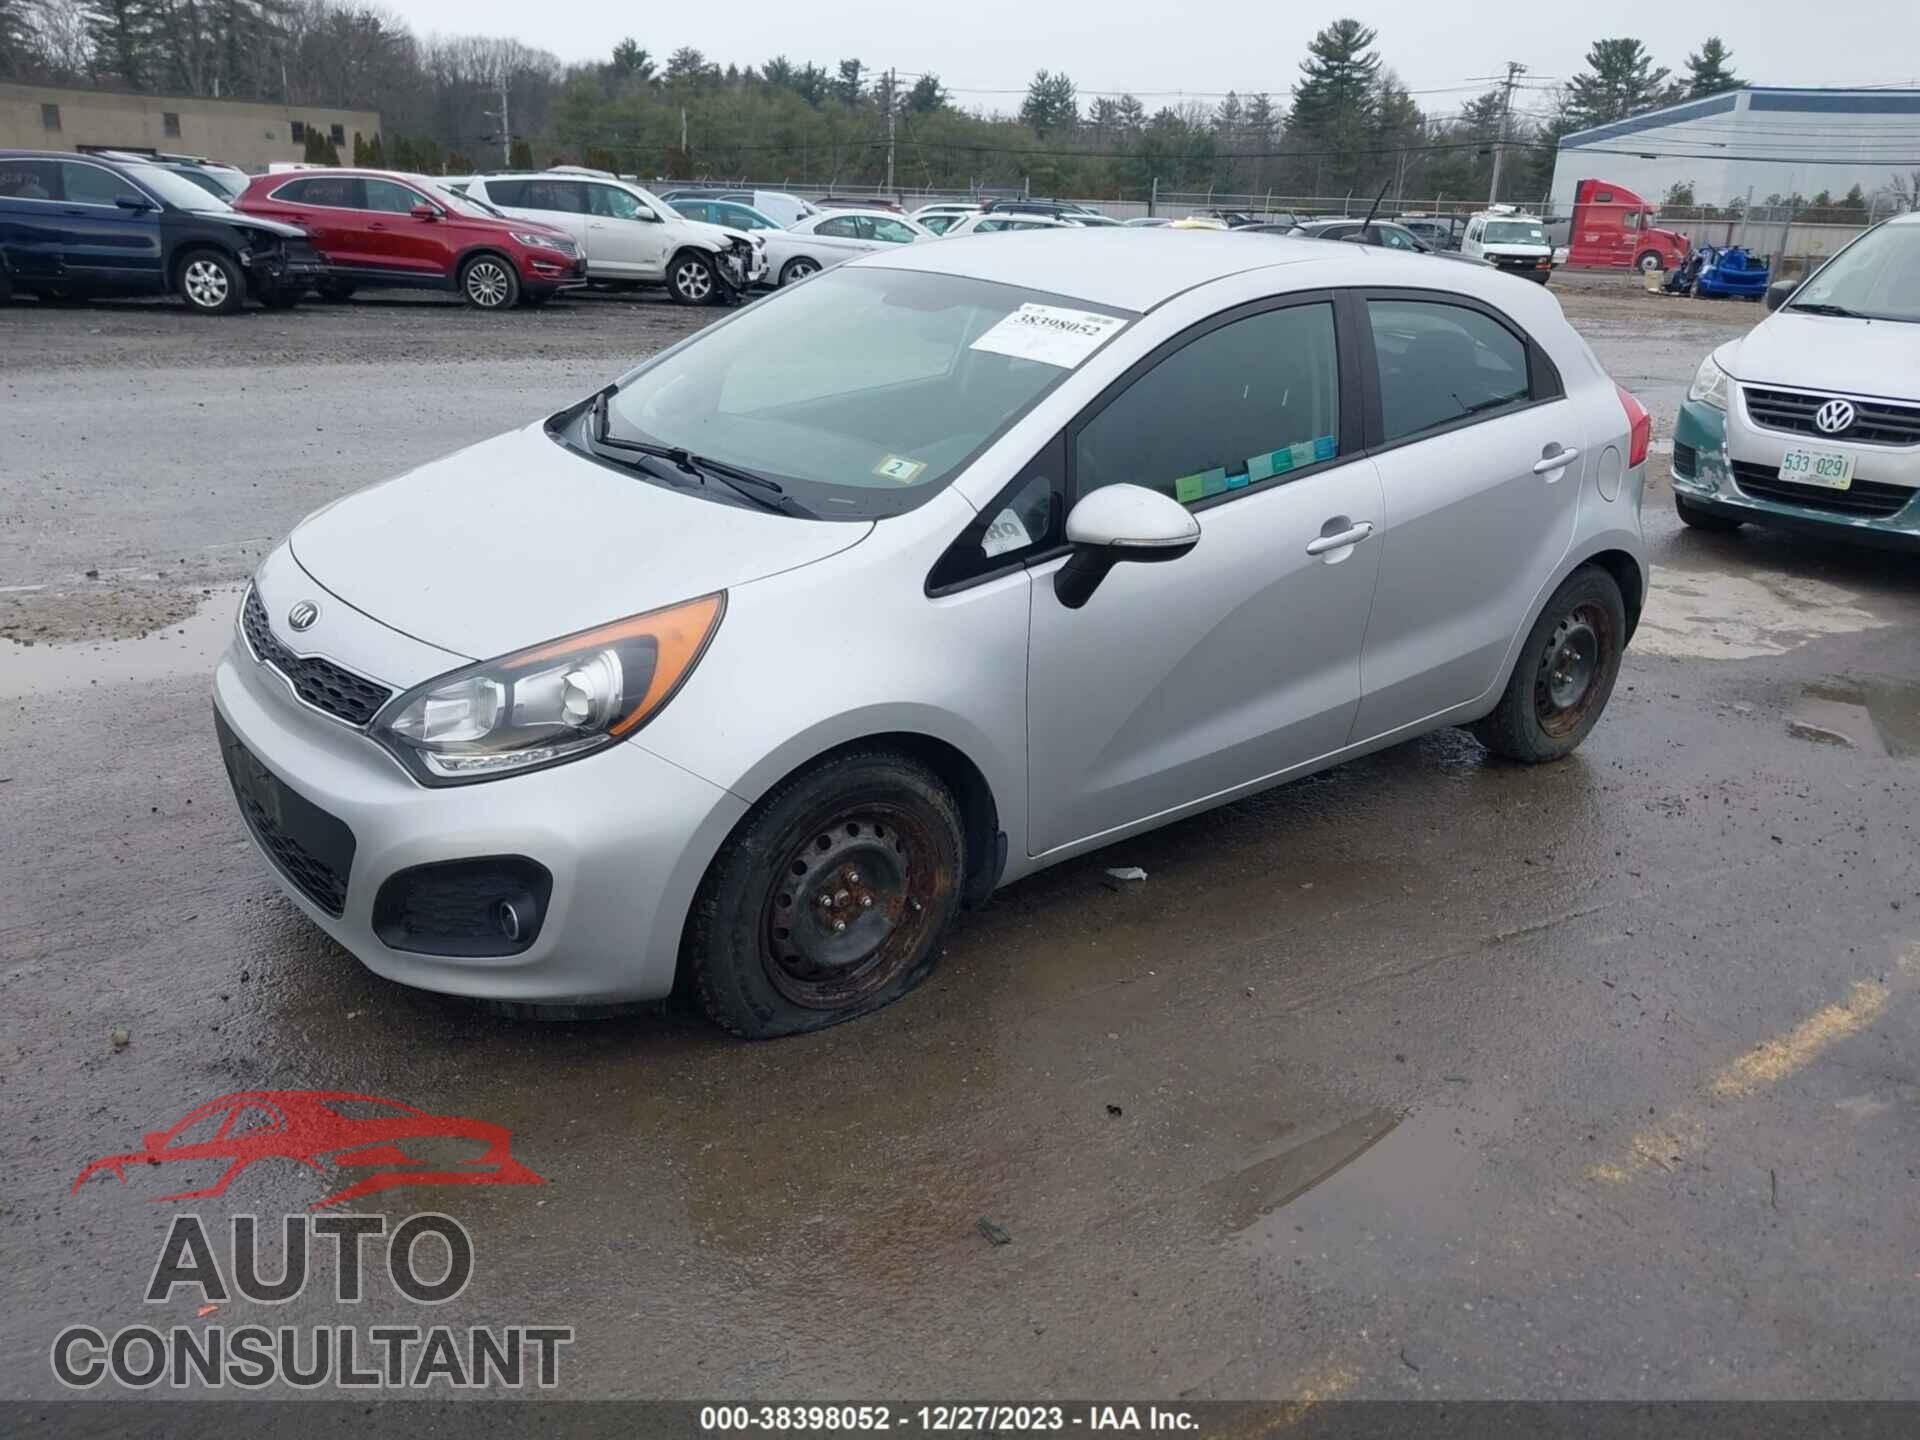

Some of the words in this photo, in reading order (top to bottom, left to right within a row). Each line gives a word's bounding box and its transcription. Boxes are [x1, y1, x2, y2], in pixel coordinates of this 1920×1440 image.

[1013, 313, 1103, 337] 38398052
[1816, 400, 1855, 433] VW
[887, 461, 904, 475] 2
[1783, 452, 1810, 472] 533
[1816, 457, 1849, 478] 0291
